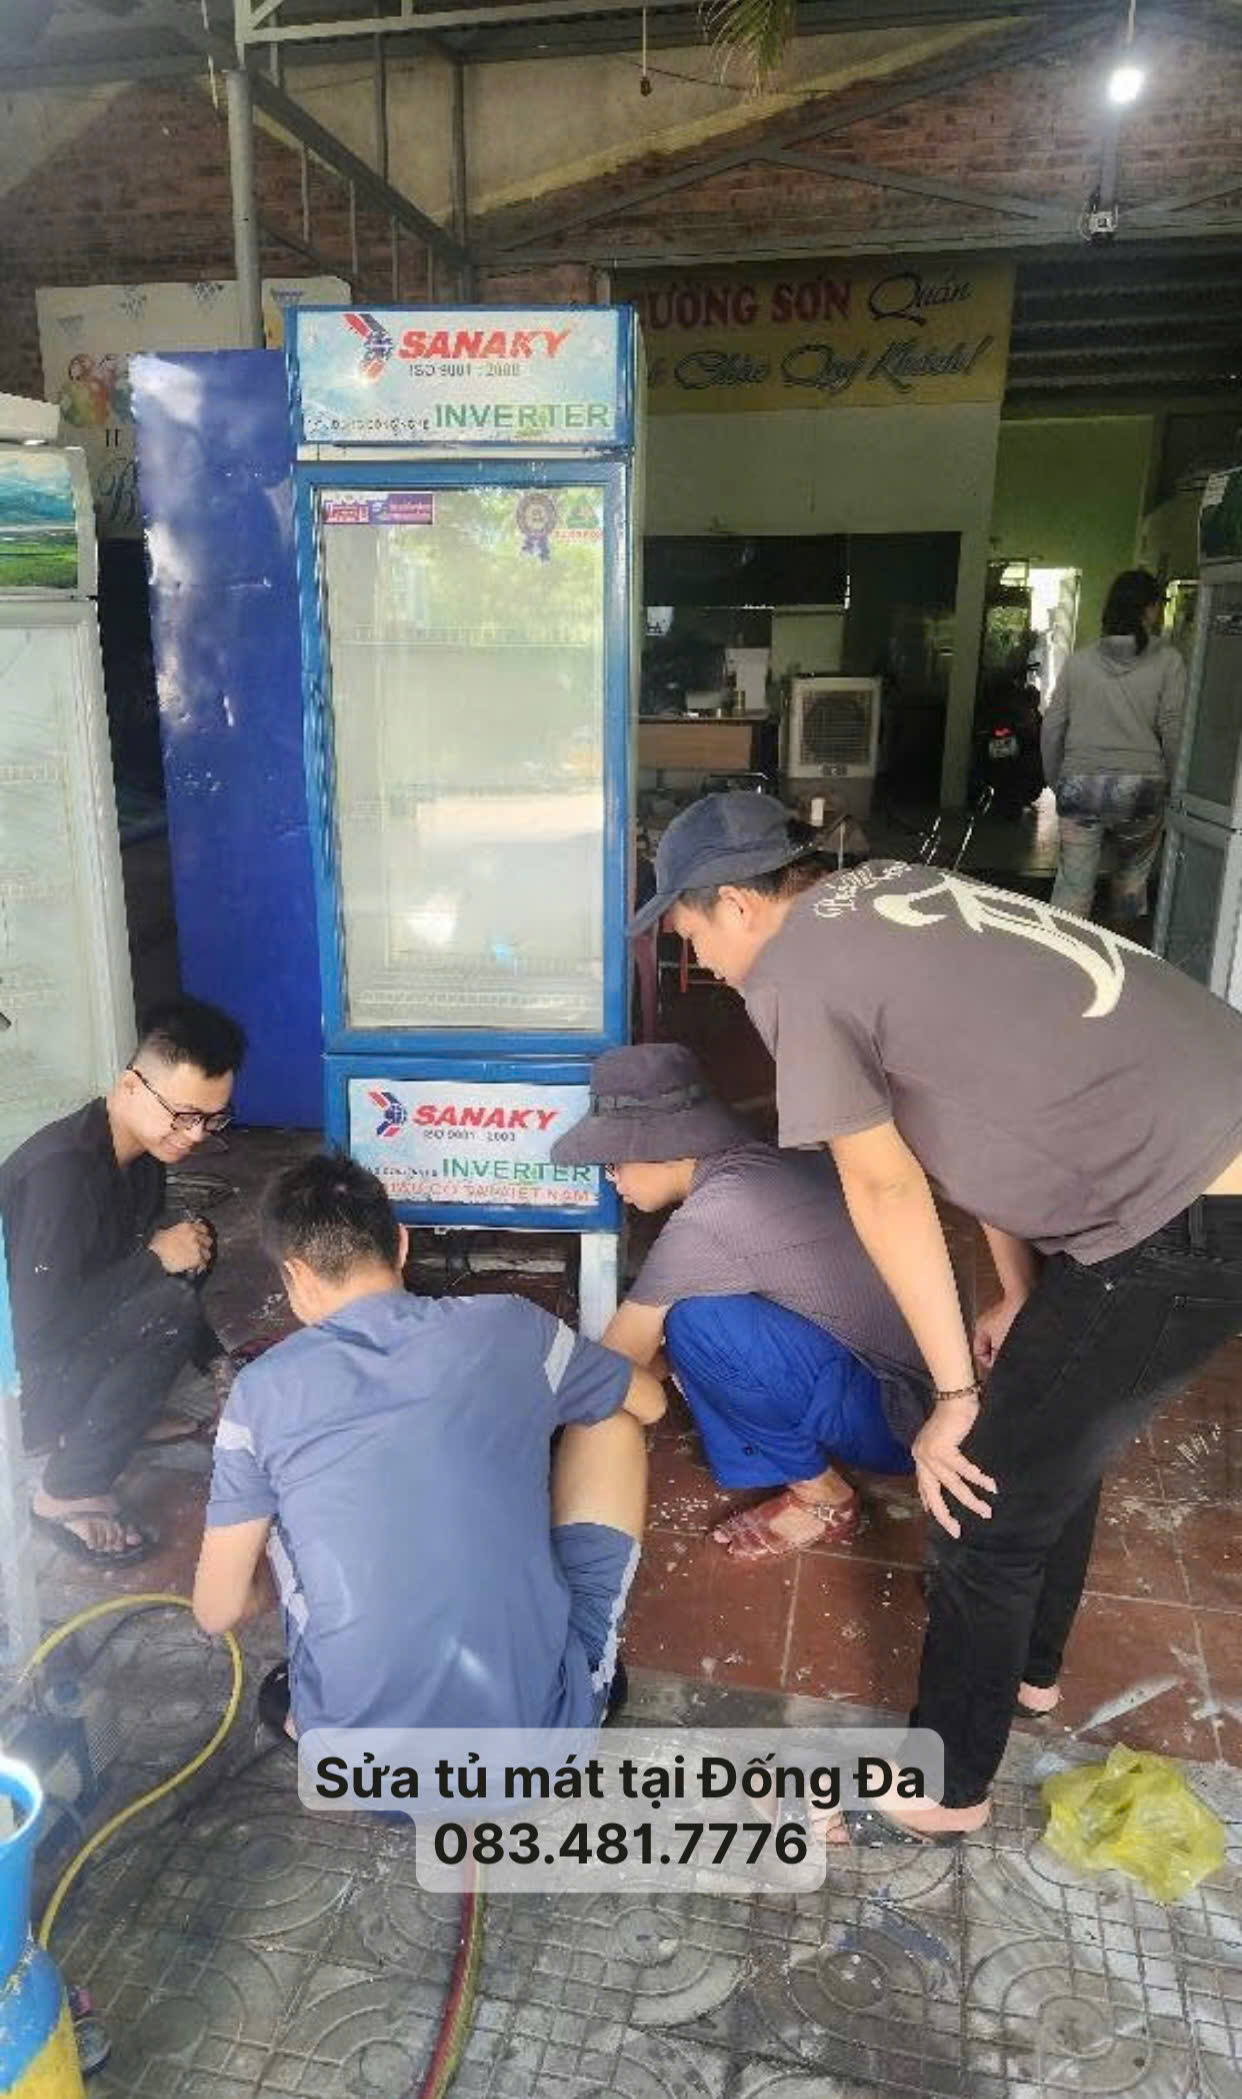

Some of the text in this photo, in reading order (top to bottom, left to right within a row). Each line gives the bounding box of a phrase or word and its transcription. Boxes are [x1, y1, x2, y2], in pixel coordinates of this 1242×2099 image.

[772, 274, 851, 322] SƠN
[867, 269, 971, 327] Quán
[398, 327, 571, 359] SANAKY
[409, 364, 435, 377] ISO
[435, 403, 611, 428] INVERTER
[412, 1104, 560, 1130] SANAKY
[442, 1157, 592, 1182] INVERTER
